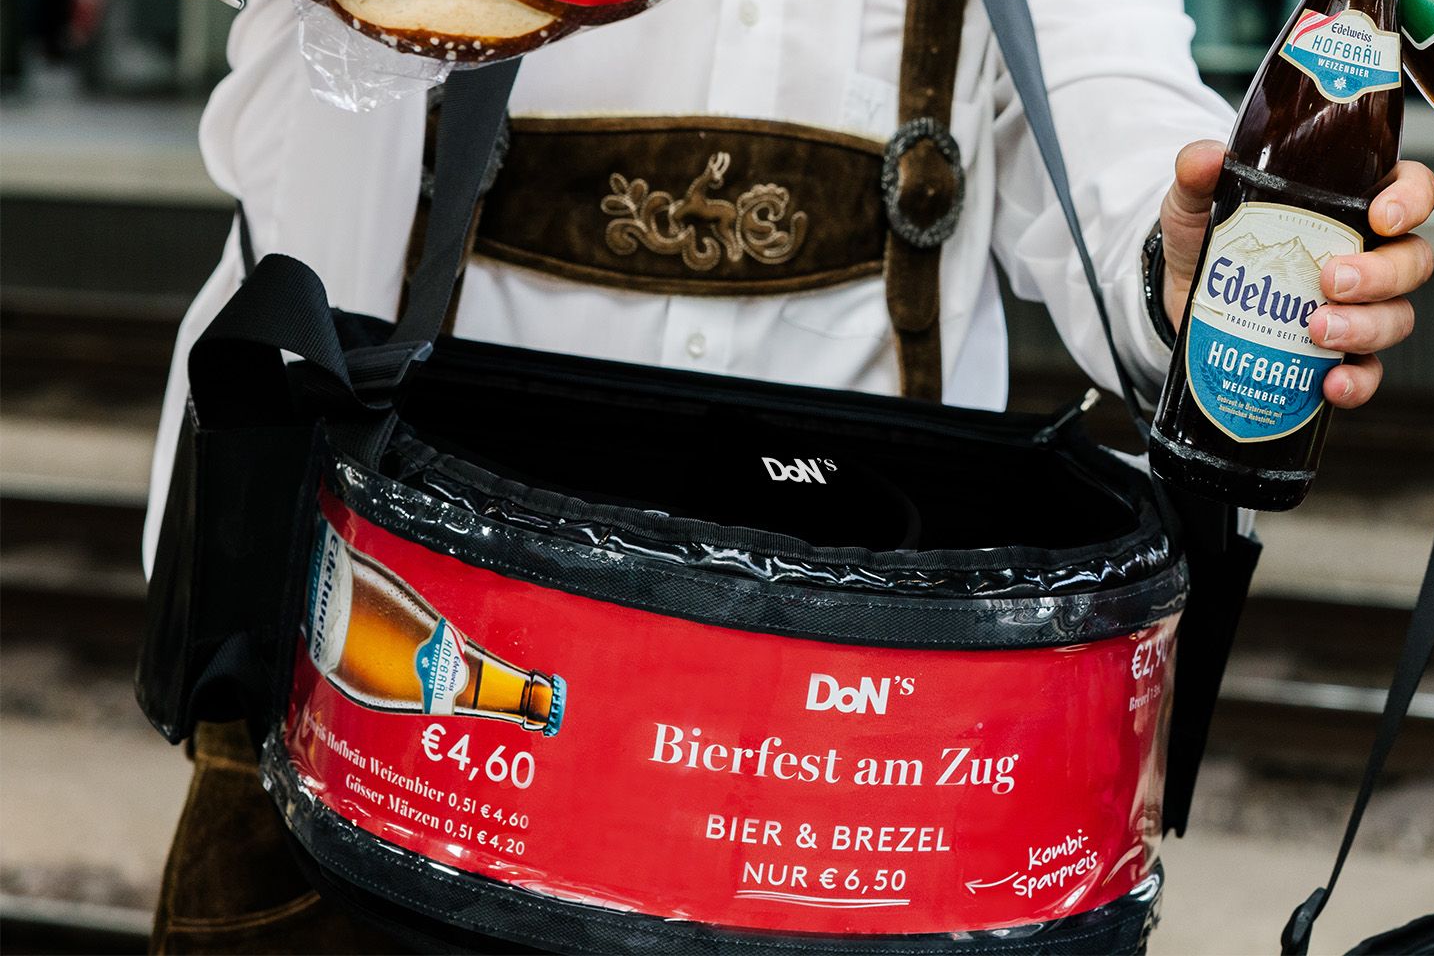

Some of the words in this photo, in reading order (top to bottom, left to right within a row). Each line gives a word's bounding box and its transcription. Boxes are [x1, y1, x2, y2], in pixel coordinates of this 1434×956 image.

[1311, 34, 1382, 66] HOFBRÄU
[1331, 22, 1372, 43] Edelweiss
[1318, 58, 1369, 78] WEIZENBIER
[1207, 256, 1328, 328] Edelwe
[1226, 313, 1273, 335] TRADITION
[1276, 330, 1297, 343] SEIT
[1207, 340, 1316, 392] HOFBRÄU
[1222, 379, 1287, 406] WEIZENBIER
[434, 638, 452, 700] HOFBRÄU
[421, 723, 535, 789] €4,60
[648, 723, 843, 784] Bierfest
[854, 758, 923, 786] am
[935, 747, 1019, 795] Zug
[345, 773, 385, 805] Gösser
[387, 793, 440, 829] Märzen
[370, 756, 445, 803] Weizenbier
[705, 813, 782, 846] BIER
[796, 823, 818, 849] &
[831, 825, 951, 852] BREZEL
[1028, 828, 1089, 871] Kombi-
[742, 861, 808, 888] NUR
[1012, 849, 1098, 899] Sparpreis
